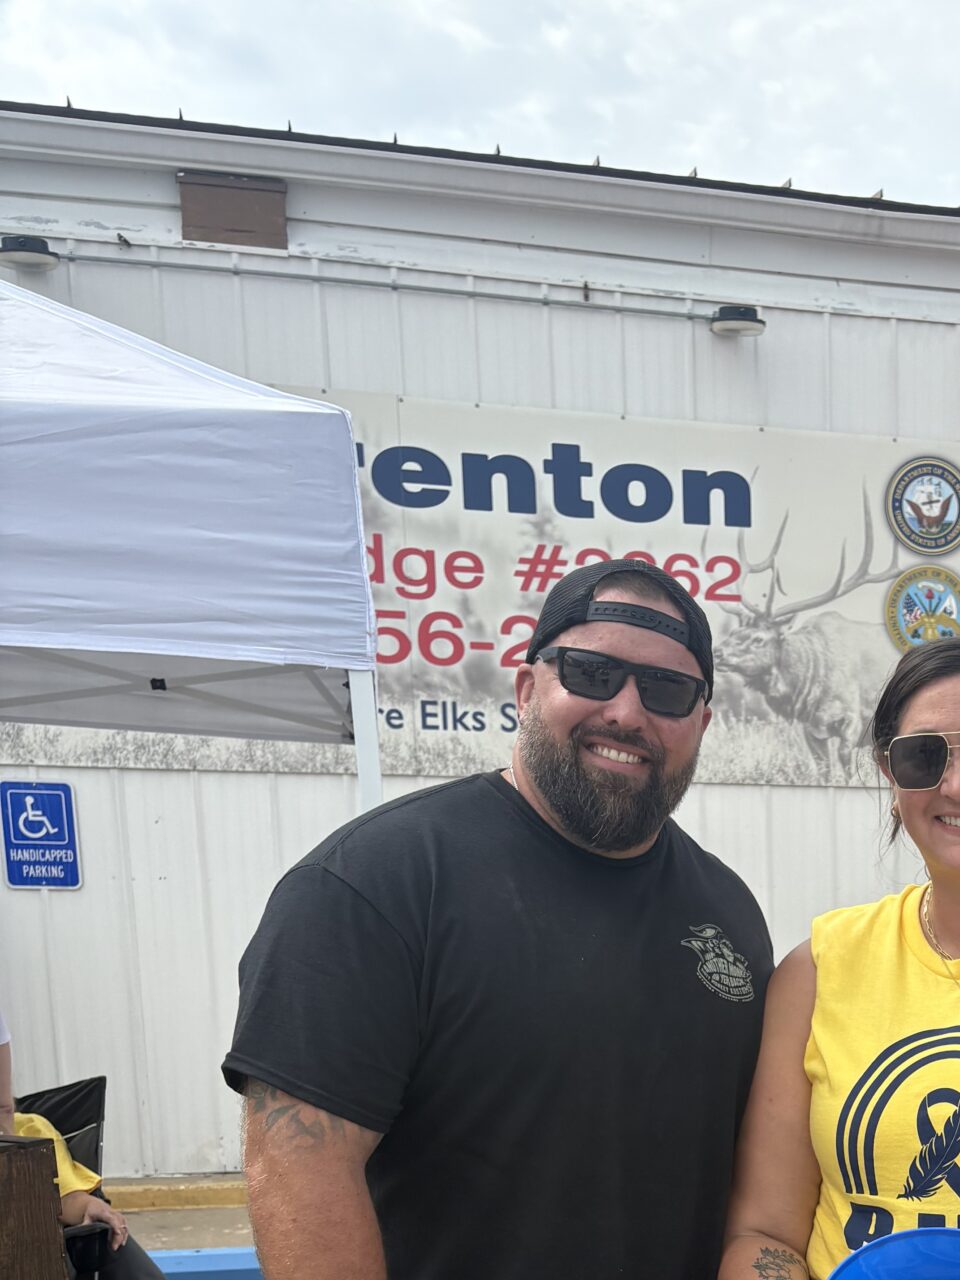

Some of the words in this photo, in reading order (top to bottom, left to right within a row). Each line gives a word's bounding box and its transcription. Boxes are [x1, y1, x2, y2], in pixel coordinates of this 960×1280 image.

[356, 442, 752, 528] enton
[420, 700, 486, 732] Elks
[10, 848, 74, 862] HANDICAPPED
[22, 864, 65, 879] PARKING
